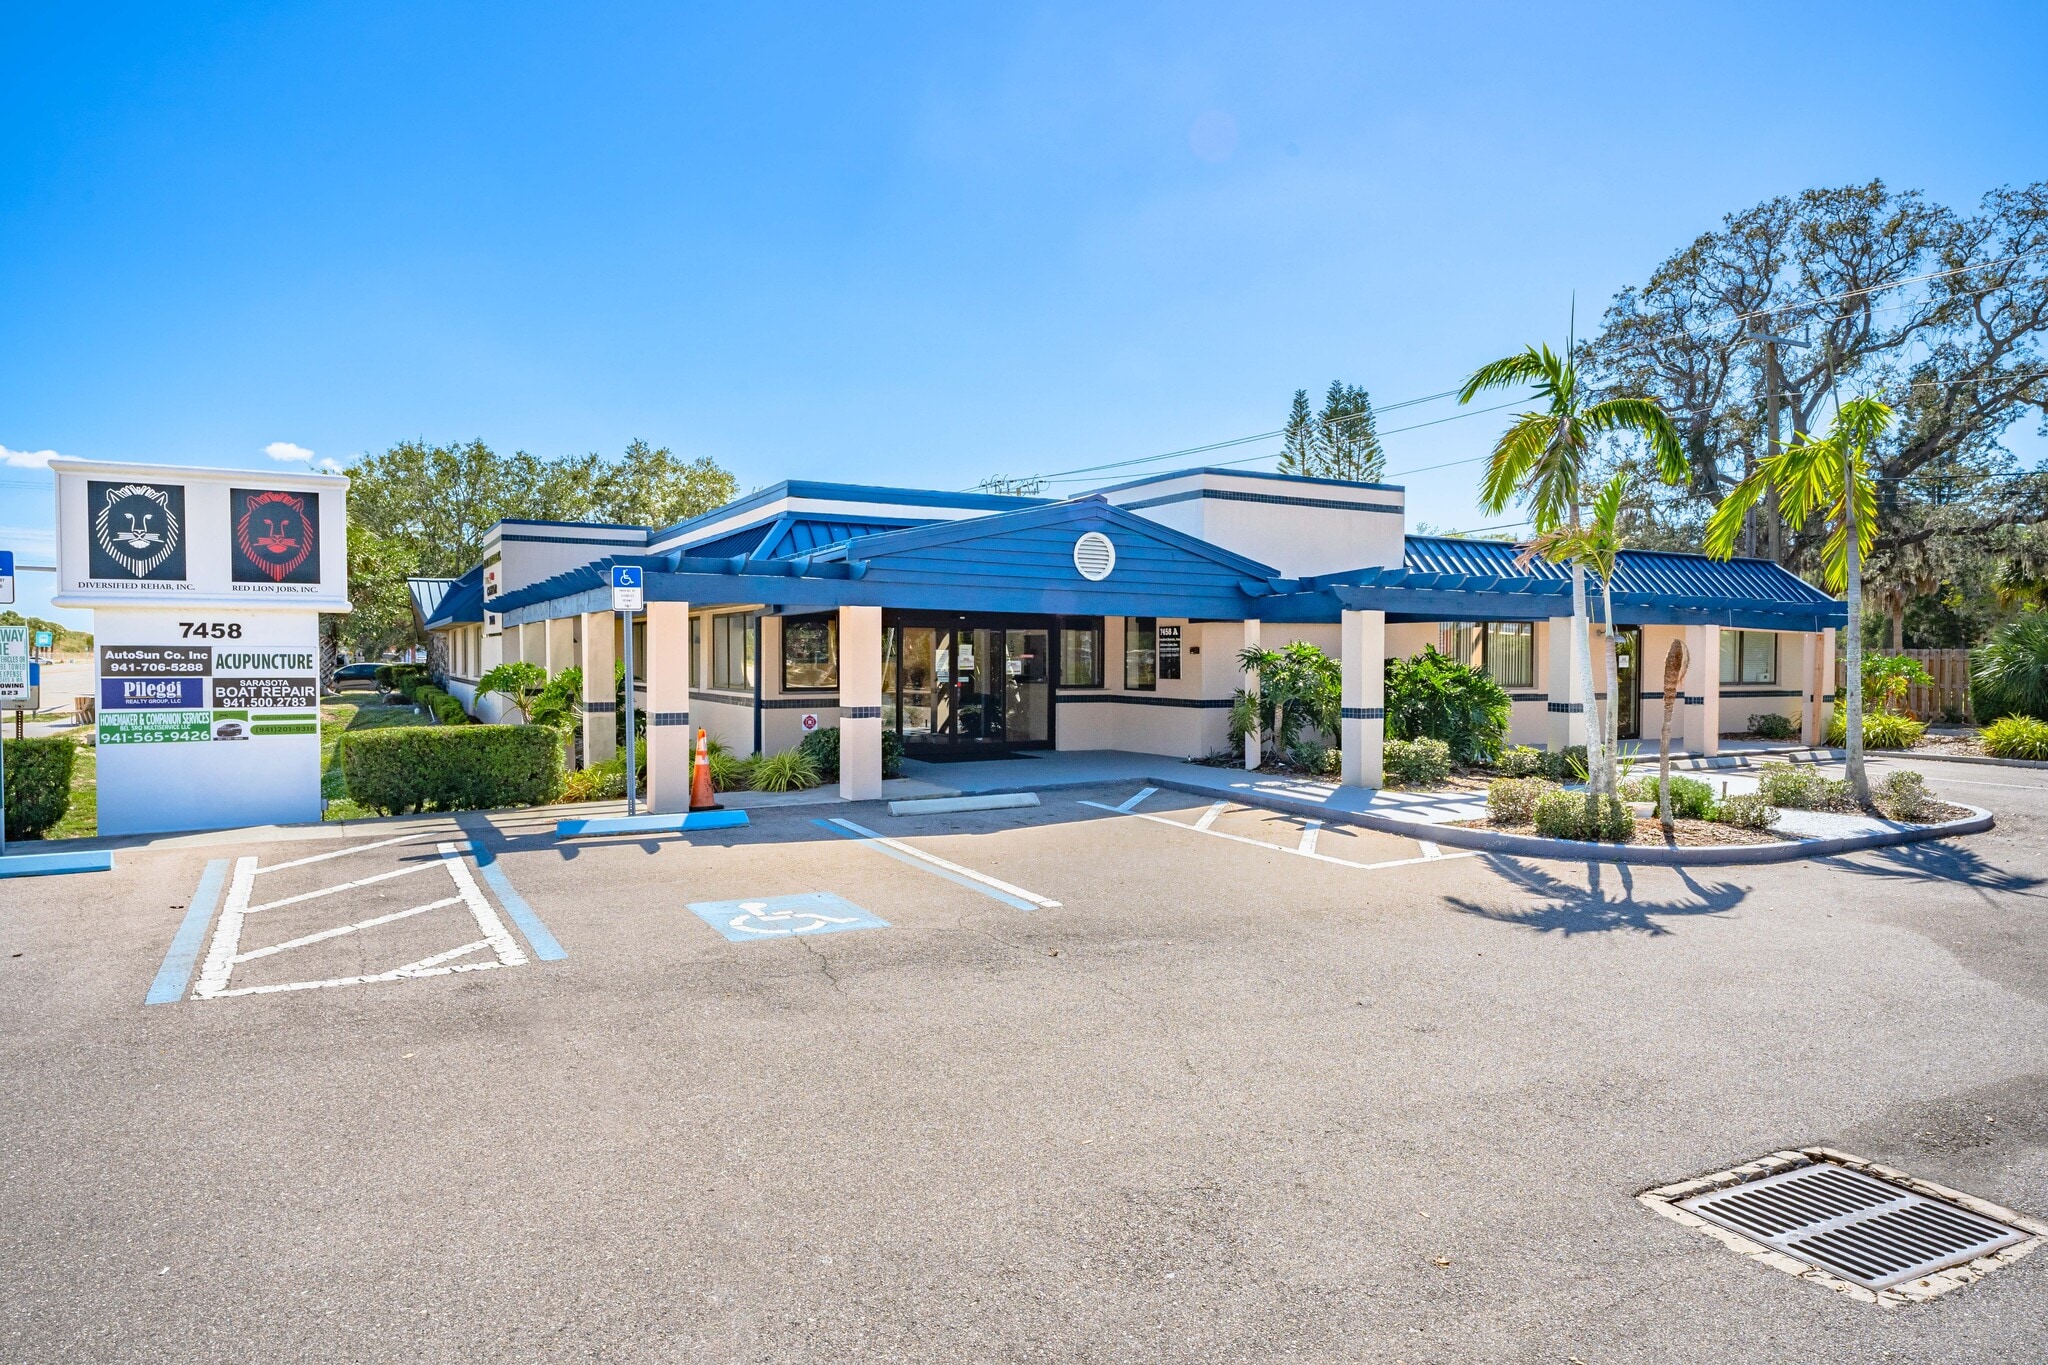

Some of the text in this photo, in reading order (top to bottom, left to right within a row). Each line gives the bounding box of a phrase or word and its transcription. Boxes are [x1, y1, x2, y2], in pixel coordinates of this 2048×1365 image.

[78, 581, 138, 589] DIVERSIFIED
[140, 582, 174, 591] REHAB,
[276, 585, 299, 593] JOBS,
[0, 629, 25, 642] WAY
[178, 622, 242, 639] 7458
[105, 650, 208, 660] AutoSun Co. Inc
[110, 663, 203, 672] 941-706-5288
[216, 653, 313, 670] ACUPUNCTURE
[239, 679, 289, 687] SARASOTA
[123, 681, 182, 699] Pileggi
[215, 686, 315, 698] BOAT REPAIR
[223, 697, 307, 707] 941.500.2783
[99, 712, 210, 726] HOMEMAKER & COMPANION SERVICES
[100, 731, 210, 743] 941-565-9426
